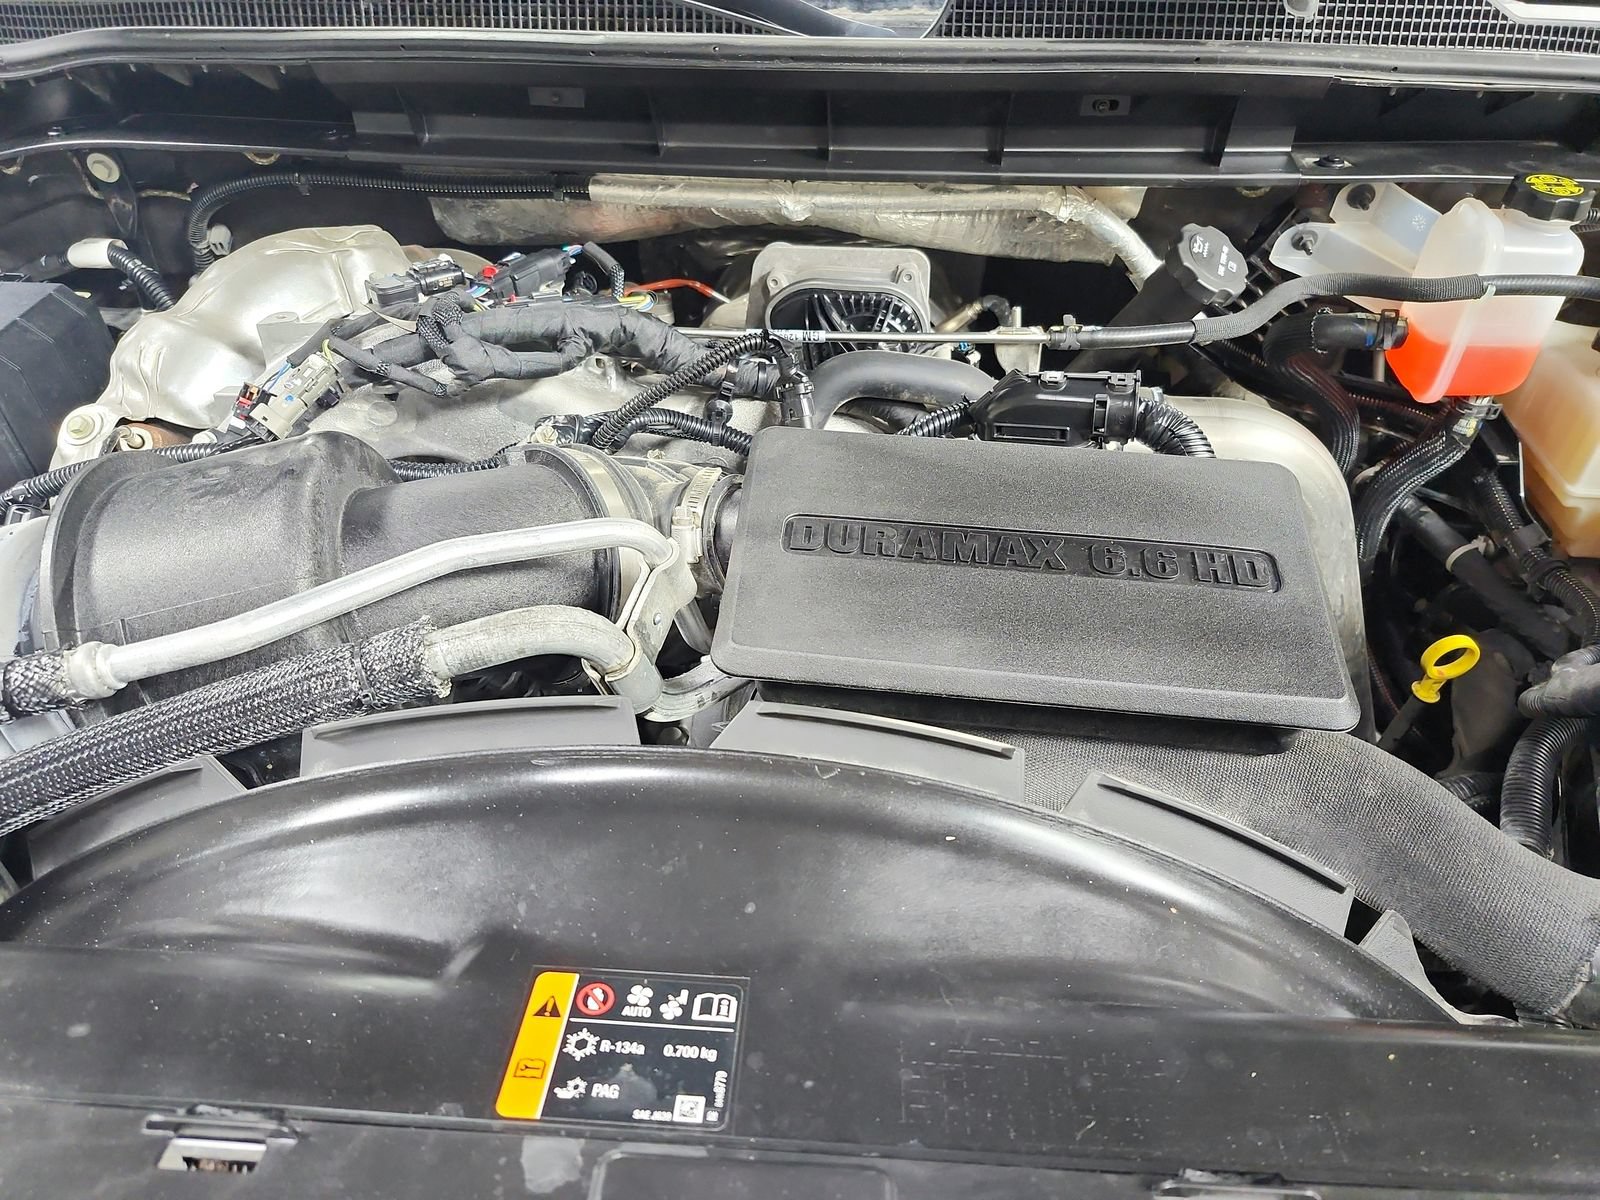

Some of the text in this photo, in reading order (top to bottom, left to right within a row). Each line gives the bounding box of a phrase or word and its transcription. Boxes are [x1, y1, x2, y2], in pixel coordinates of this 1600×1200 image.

[802, 331, 820, 342] GM
[788, 521, 1272, 589] DURAMAX 6.6 HD
[621, 1005, 652, 1018] AUTO
[599, 1039, 718, 1063] R-134a 0.700 kg
[591, 1083, 620, 1099] PAG
